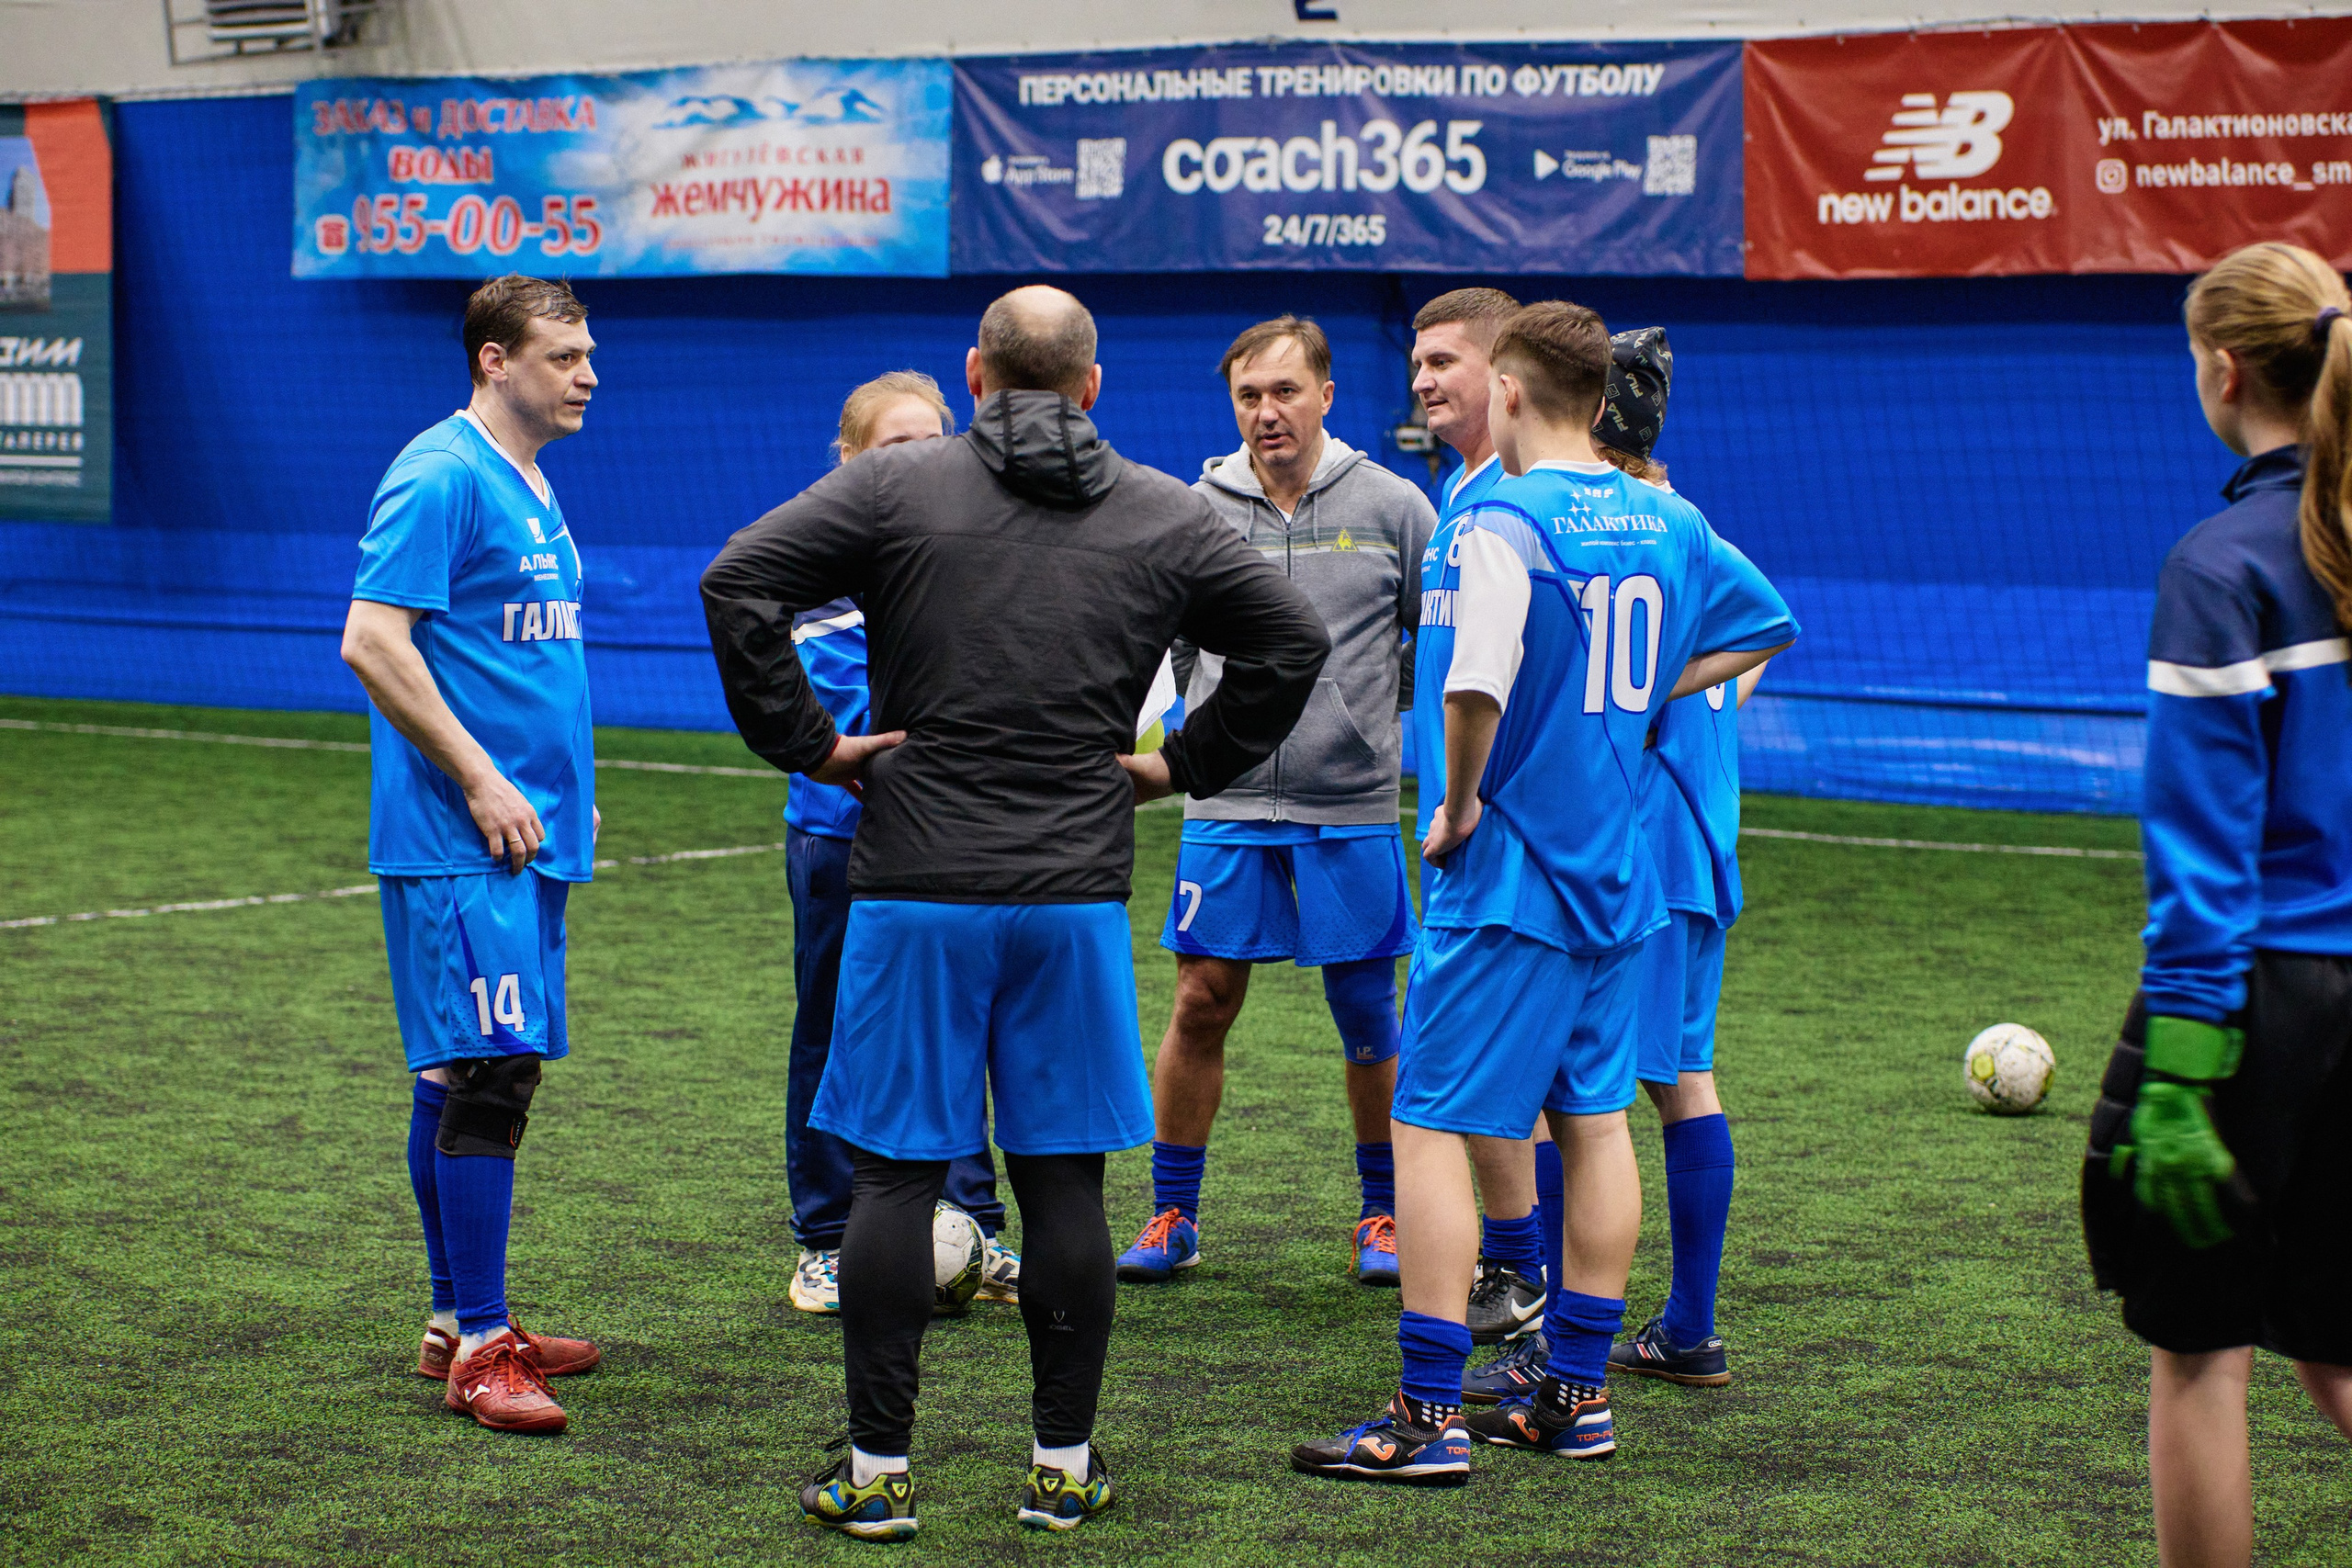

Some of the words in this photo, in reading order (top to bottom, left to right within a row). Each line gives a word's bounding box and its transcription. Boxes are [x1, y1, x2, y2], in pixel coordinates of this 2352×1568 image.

[1018, 67, 1252, 106] ПЕРСОНАЛЬНЫЕ
[1255, 63, 1455, 97] ТРЕНИРОВКИ
[1460, 64, 1507, 97] ПО
[1511, 62, 1666, 98] ФУТБОЛУ
[311, 97, 408, 136] ЗАКАЗ
[436, 95, 596, 141] ДОСТАВКА
[2098, 116, 2139, 147] ул.
[1161, 119, 1487, 195] coach365
[353, 194, 603, 256] 955-00-55
[1818, 190, 1895, 225] new
[1899, 180, 2054, 223] balance
[1263, 212, 1386, 247] 24/7/365
[1550, 513, 1668, 535] ГАЛАКТИКА
[1580, 572, 1663, 714] 10
[1177, 879, 1204, 932] 7
[469, 973, 526, 1036] 14
